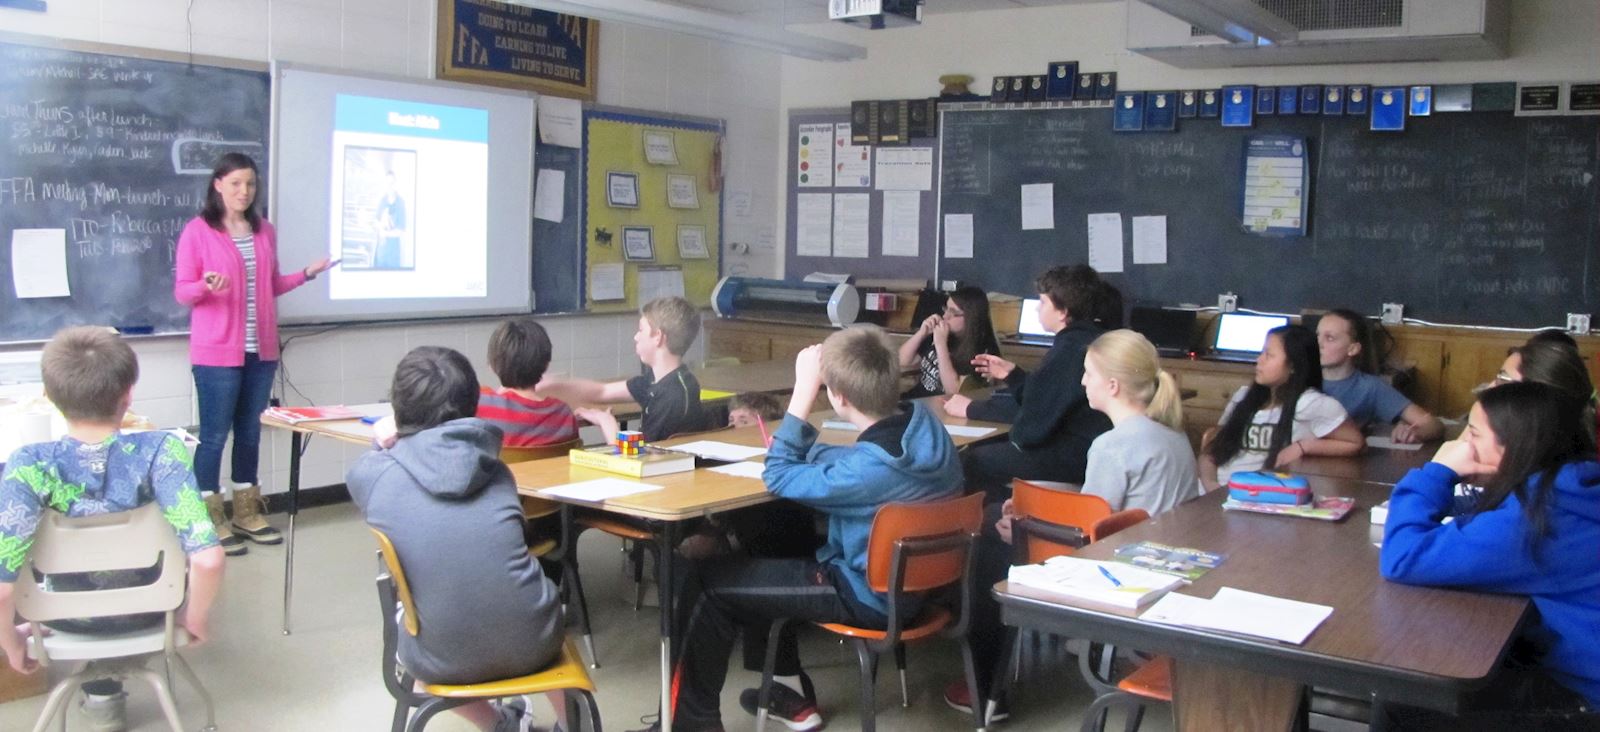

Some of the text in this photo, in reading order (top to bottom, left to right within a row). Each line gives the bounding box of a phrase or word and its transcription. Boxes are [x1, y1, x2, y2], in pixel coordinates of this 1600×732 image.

[478, 12, 548, 37] DOING TO LEARN
[458, 23, 489, 65] FFA
[495, 35, 567, 59] EARNING TO LIVE
[511, 56, 581, 80] LIVING TO SERVE
[0, 176, 35, 204] FFA
